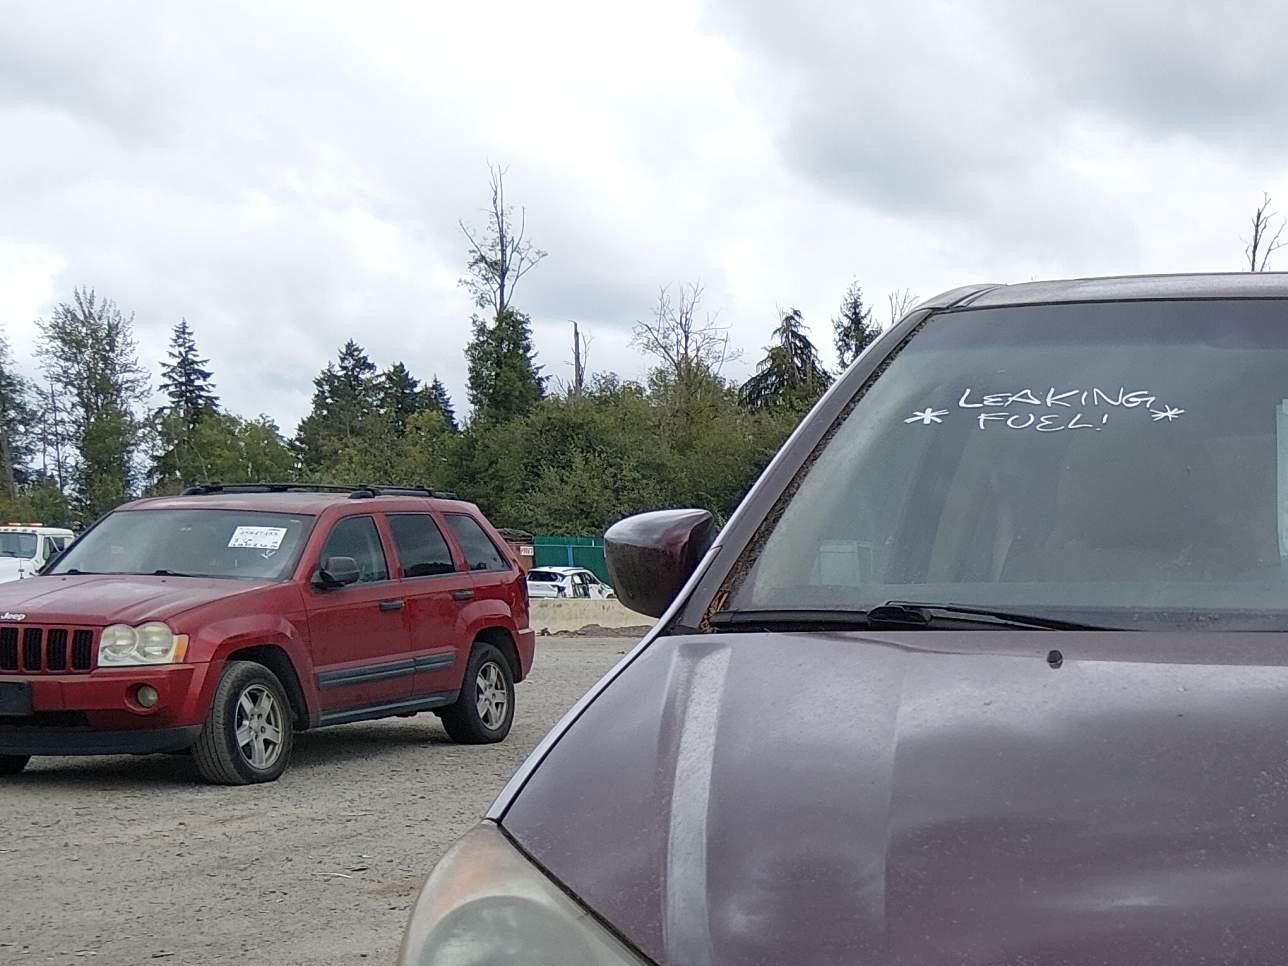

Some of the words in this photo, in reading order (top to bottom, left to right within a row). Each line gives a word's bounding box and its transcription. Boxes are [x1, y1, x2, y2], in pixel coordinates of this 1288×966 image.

[958, 387, 1155, 408] LEAKING
[977, 413, 1108, 431] FUEL!
[0, 612, 26, 621] Jeep
